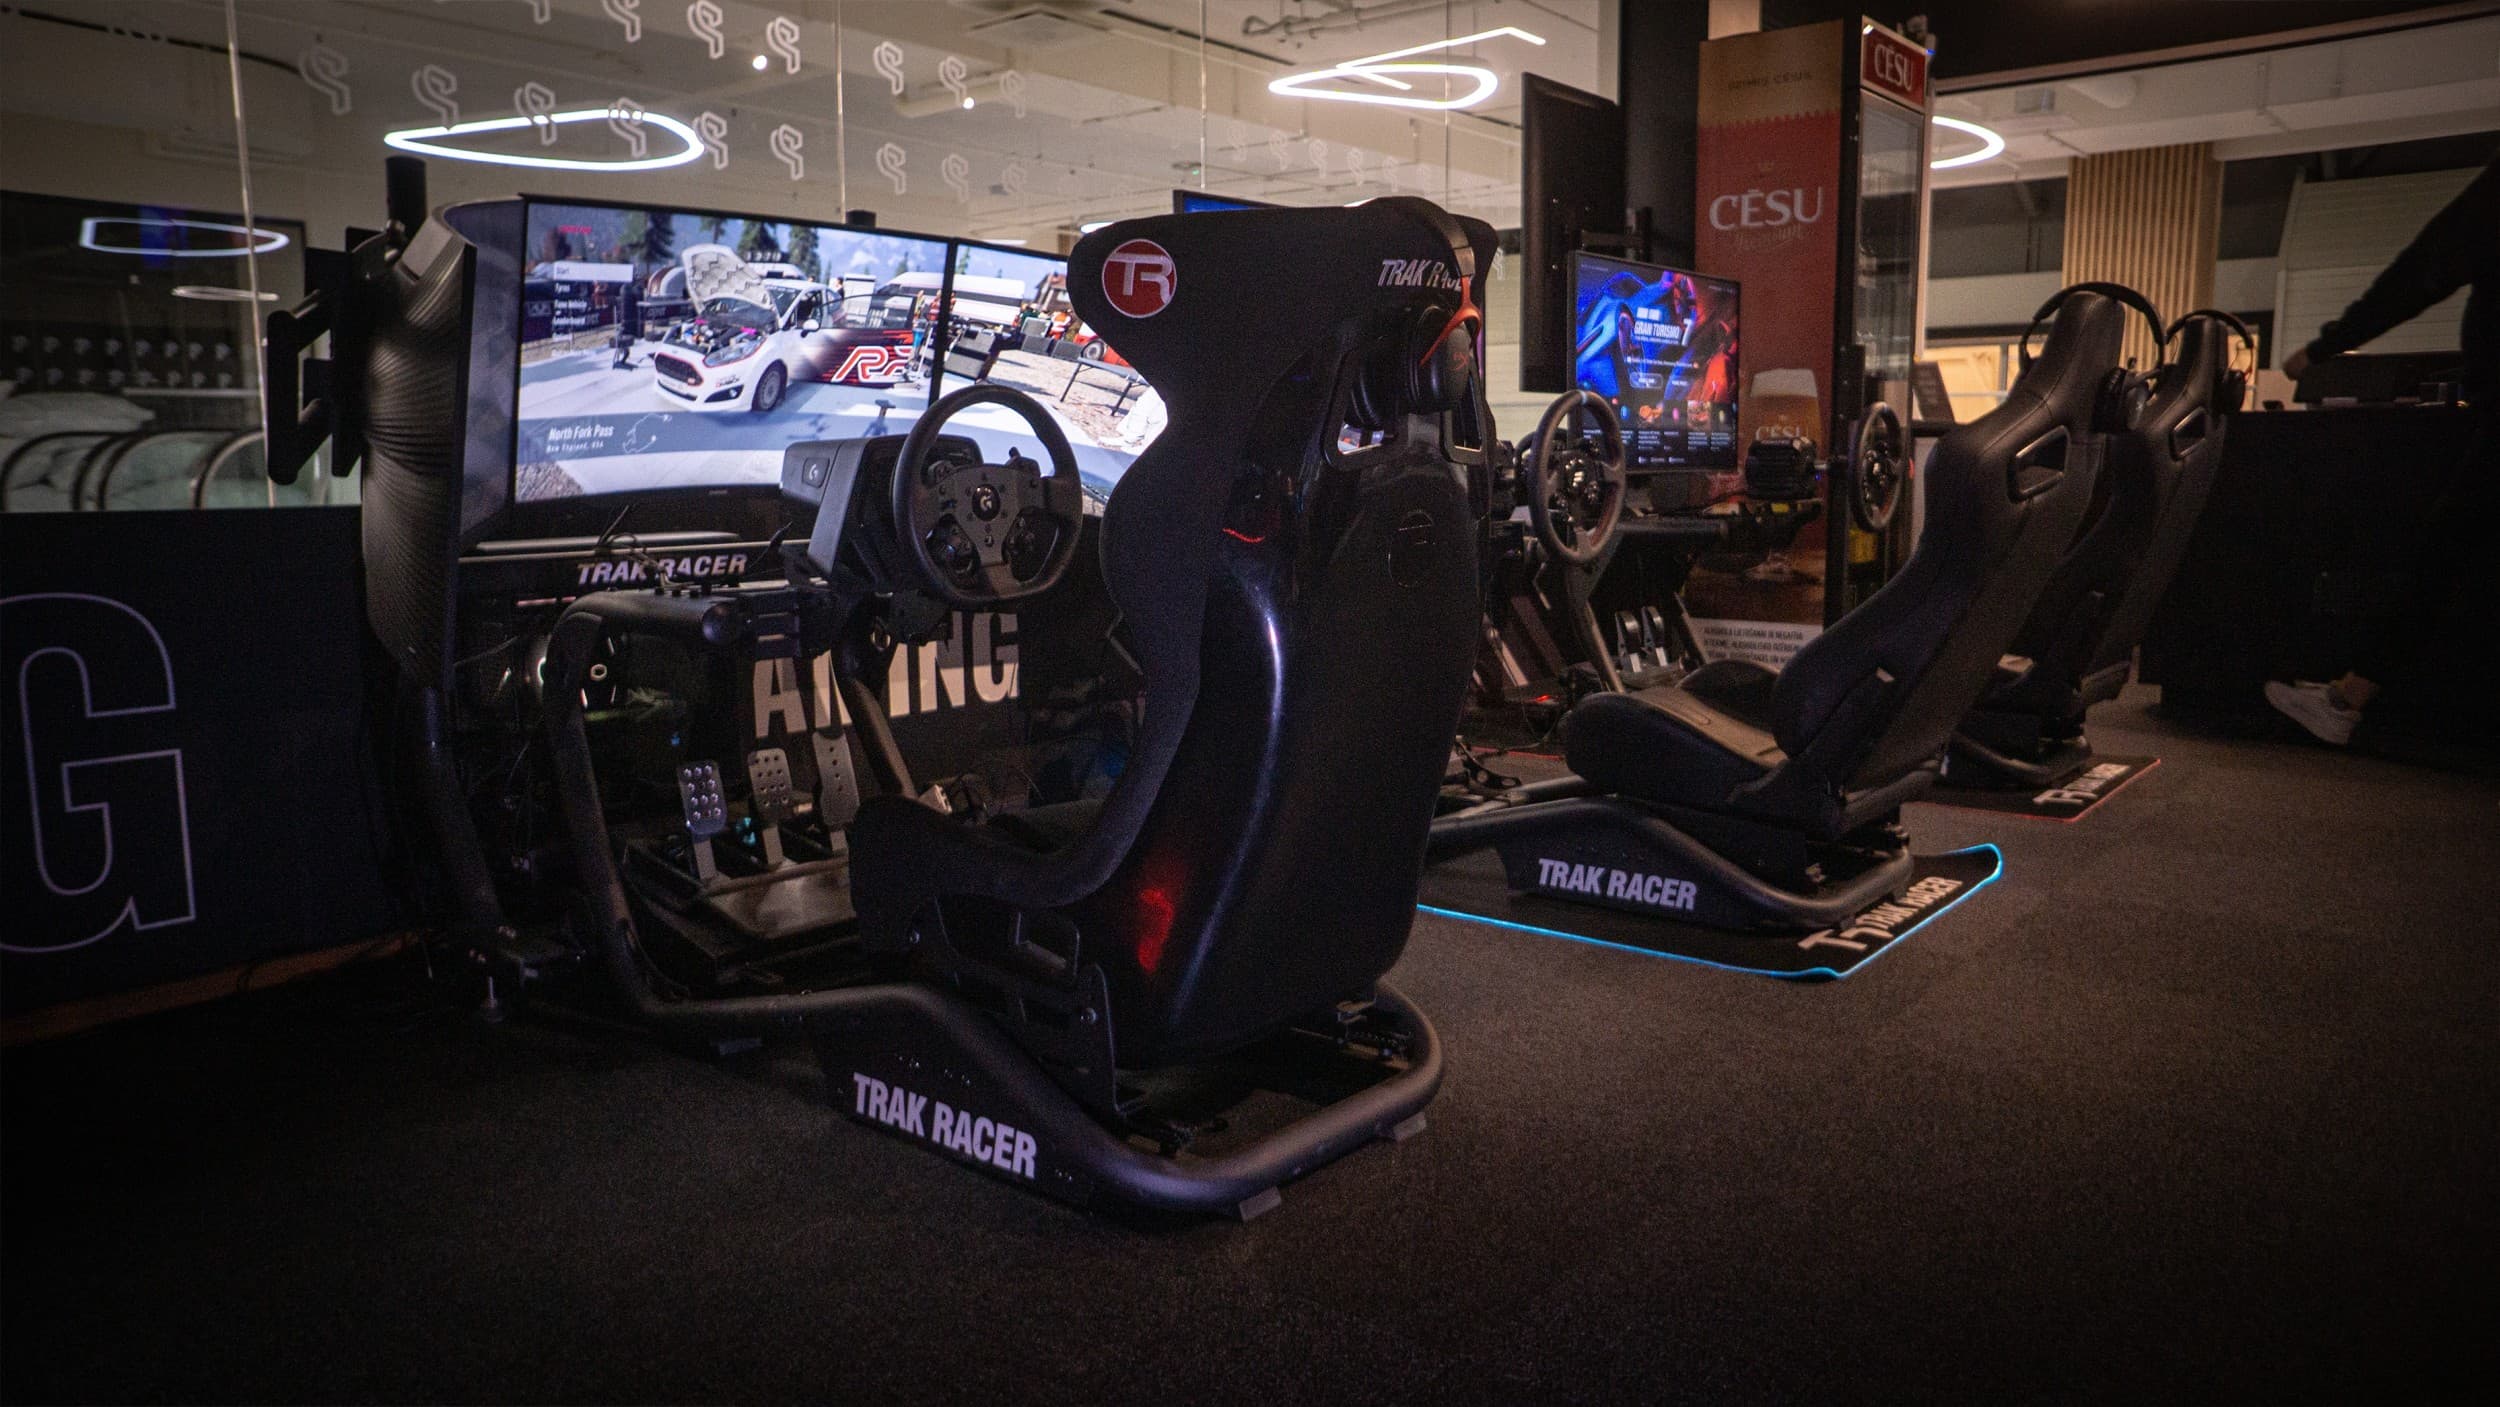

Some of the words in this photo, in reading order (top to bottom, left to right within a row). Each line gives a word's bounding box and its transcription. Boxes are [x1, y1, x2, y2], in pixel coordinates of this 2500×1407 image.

[1708, 186, 1823, 231] CĒSU
[1377, 258, 1432, 287] TRAK
[1634, 320, 1652, 335] GRAN
[1681, 317, 1693, 346] 7
[549, 426, 573, 442] North
[573, 425, 592, 440] Fork
[593, 424, 615, 438] Pass
[577, 560, 647, 585] TRAK
[655, 554, 748, 579] RACER
[1538, 857, 1605, 897] TRAK
[1606, 866, 1698, 912] RACER
[853, 1071, 928, 1138] TRAK
[931, 1100, 1038, 1180] RACER
